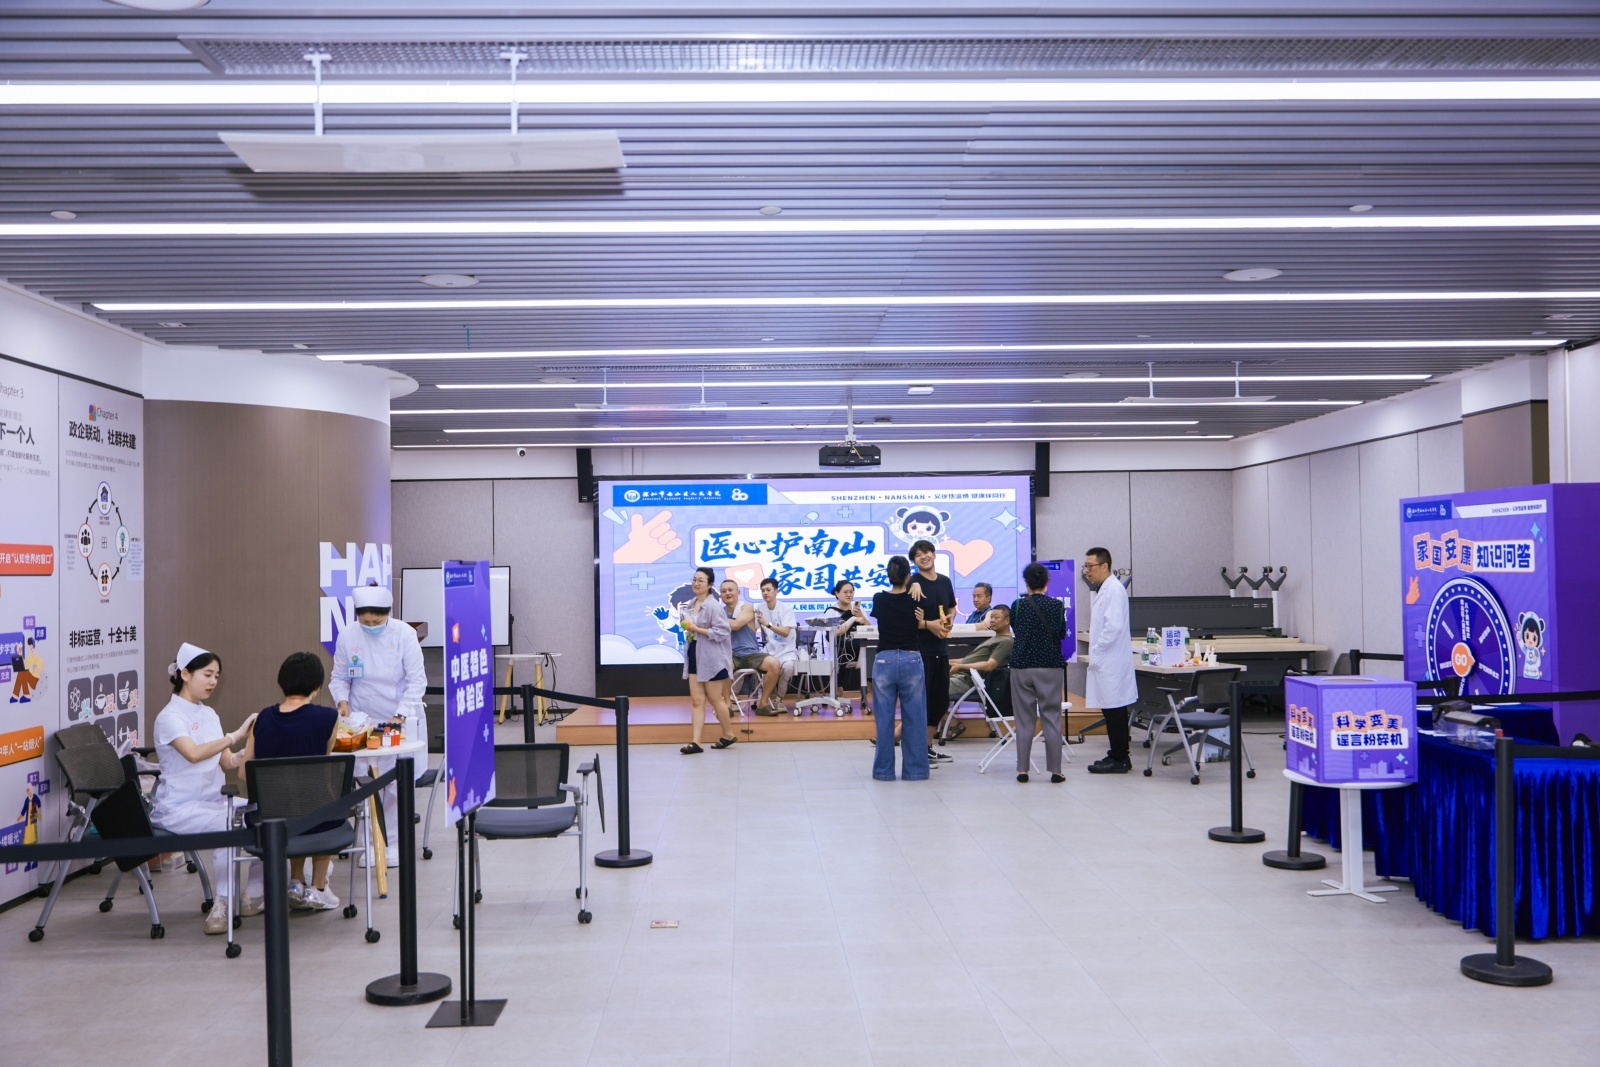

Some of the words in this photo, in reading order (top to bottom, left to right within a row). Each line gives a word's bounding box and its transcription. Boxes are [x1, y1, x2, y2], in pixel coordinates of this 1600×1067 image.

[69, 421, 137, 450] 政企联动，社群共建
[700, 528, 876, 562] 医心护南山
[768, 563, 919, 596] 家国共安
[69, 625, 137, 649] 非标运营，十全十美
[1166, 630, 1181, 638] 运动
[1166, 638, 1181, 647] 医学
[450, 648, 489, 684] 中医特色
[1454, 653, 1468, 667] GO
[456, 681, 485, 717] 体验区
[1336, 713, 1399, 731] 科学变美
[1336, 733, 1403, 747] 谣言粉碎机
